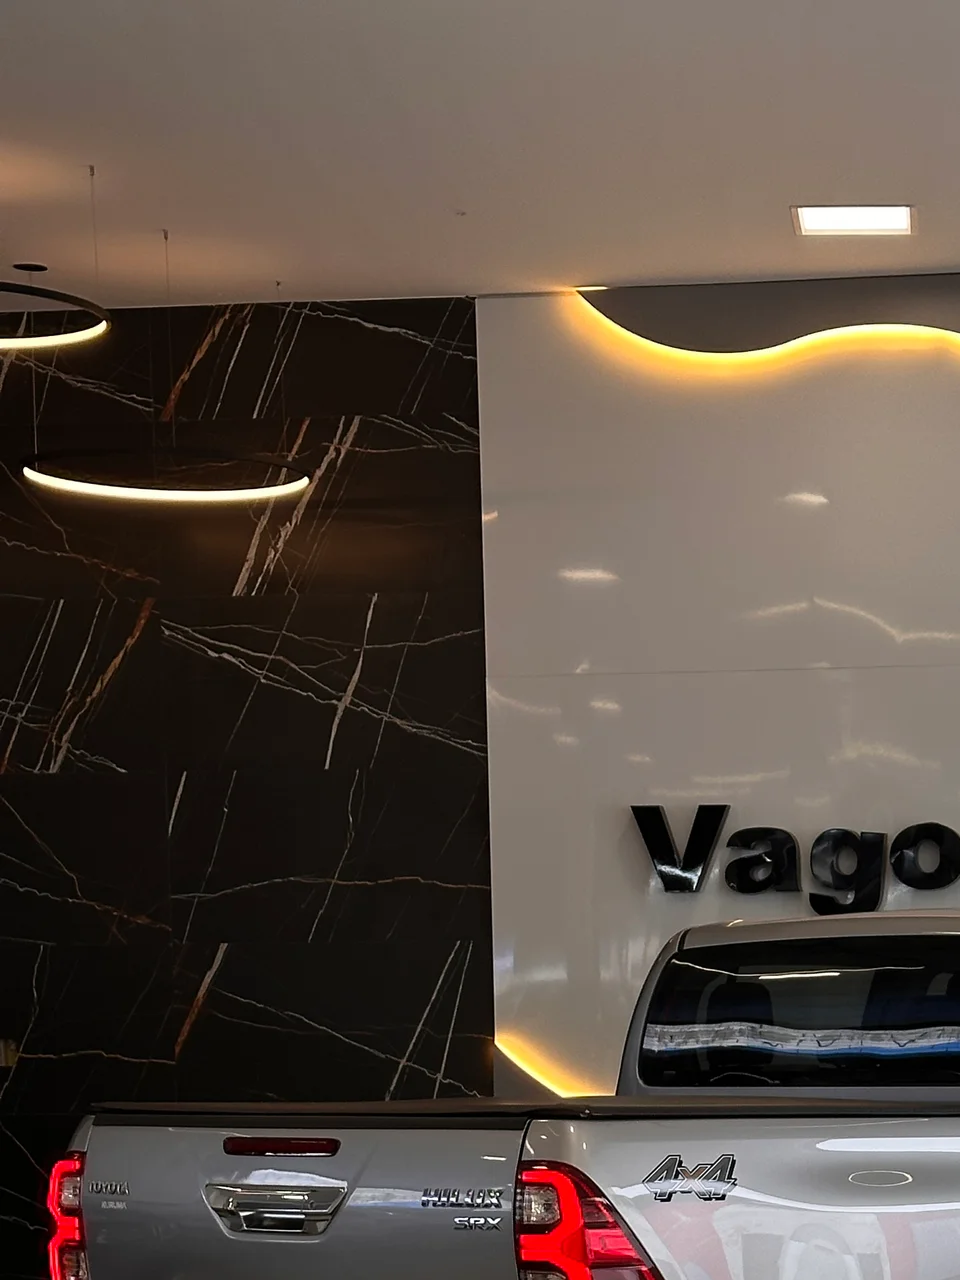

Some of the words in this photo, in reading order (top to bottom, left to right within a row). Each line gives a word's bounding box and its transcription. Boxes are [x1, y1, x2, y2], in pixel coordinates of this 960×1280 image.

[88, 1180, 131, 1195] TOYOTA
[421, 1187, 504, 1208] HILUX
[453, 1216, 503, 1231] SRX
